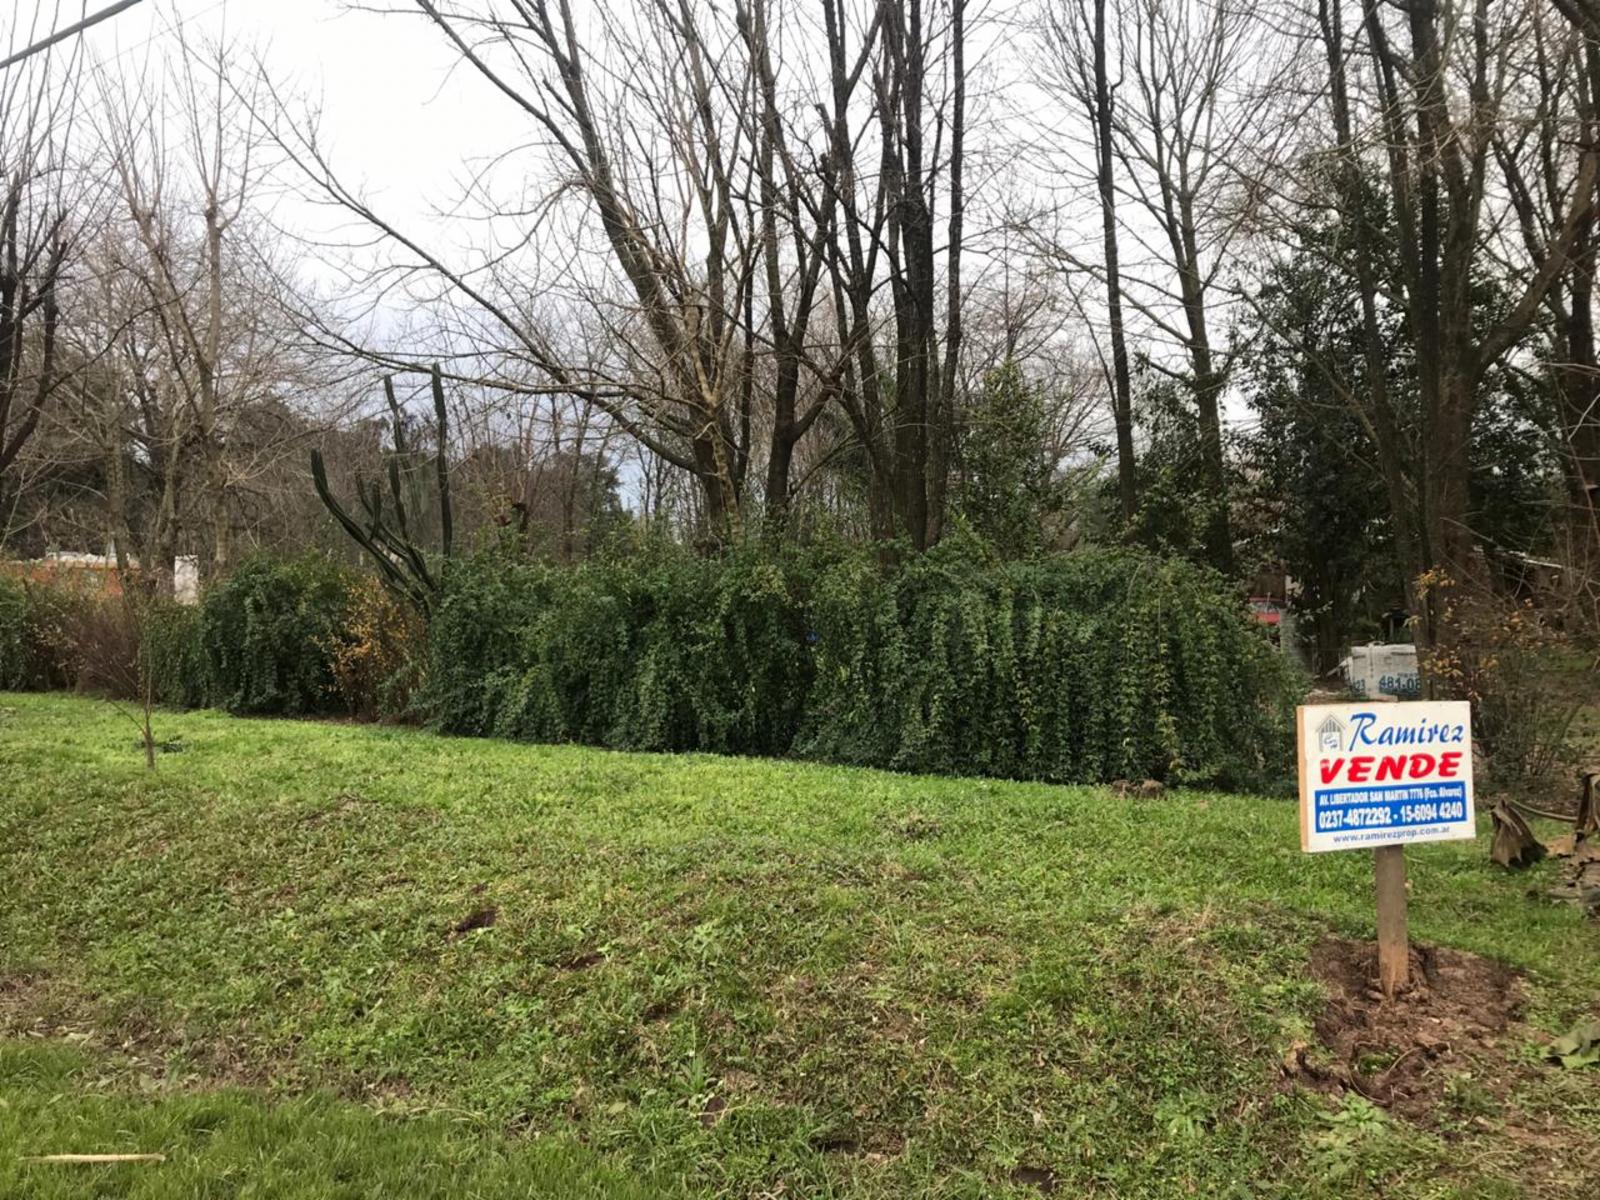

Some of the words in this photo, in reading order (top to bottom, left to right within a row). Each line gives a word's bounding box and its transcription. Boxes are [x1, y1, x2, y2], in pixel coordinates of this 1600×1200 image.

[1349, 713, 1464, 752] Ramirez
[1320, 752, 1463, 784] VENDE
[1329, 790, 1369, 805] LIBERTADOR
[1370, 790, 1383, 803] SAN
[1385, 789, 1408, 802] MARTIN
[1319, 807, 1392, 829] 0237-4872292
[1400, 803, 1437, 823] 15-6094
[1439, 801, 1463, 818] 4240
[1334, 825, 1450, 843] www.ramirezprop.com.ar
